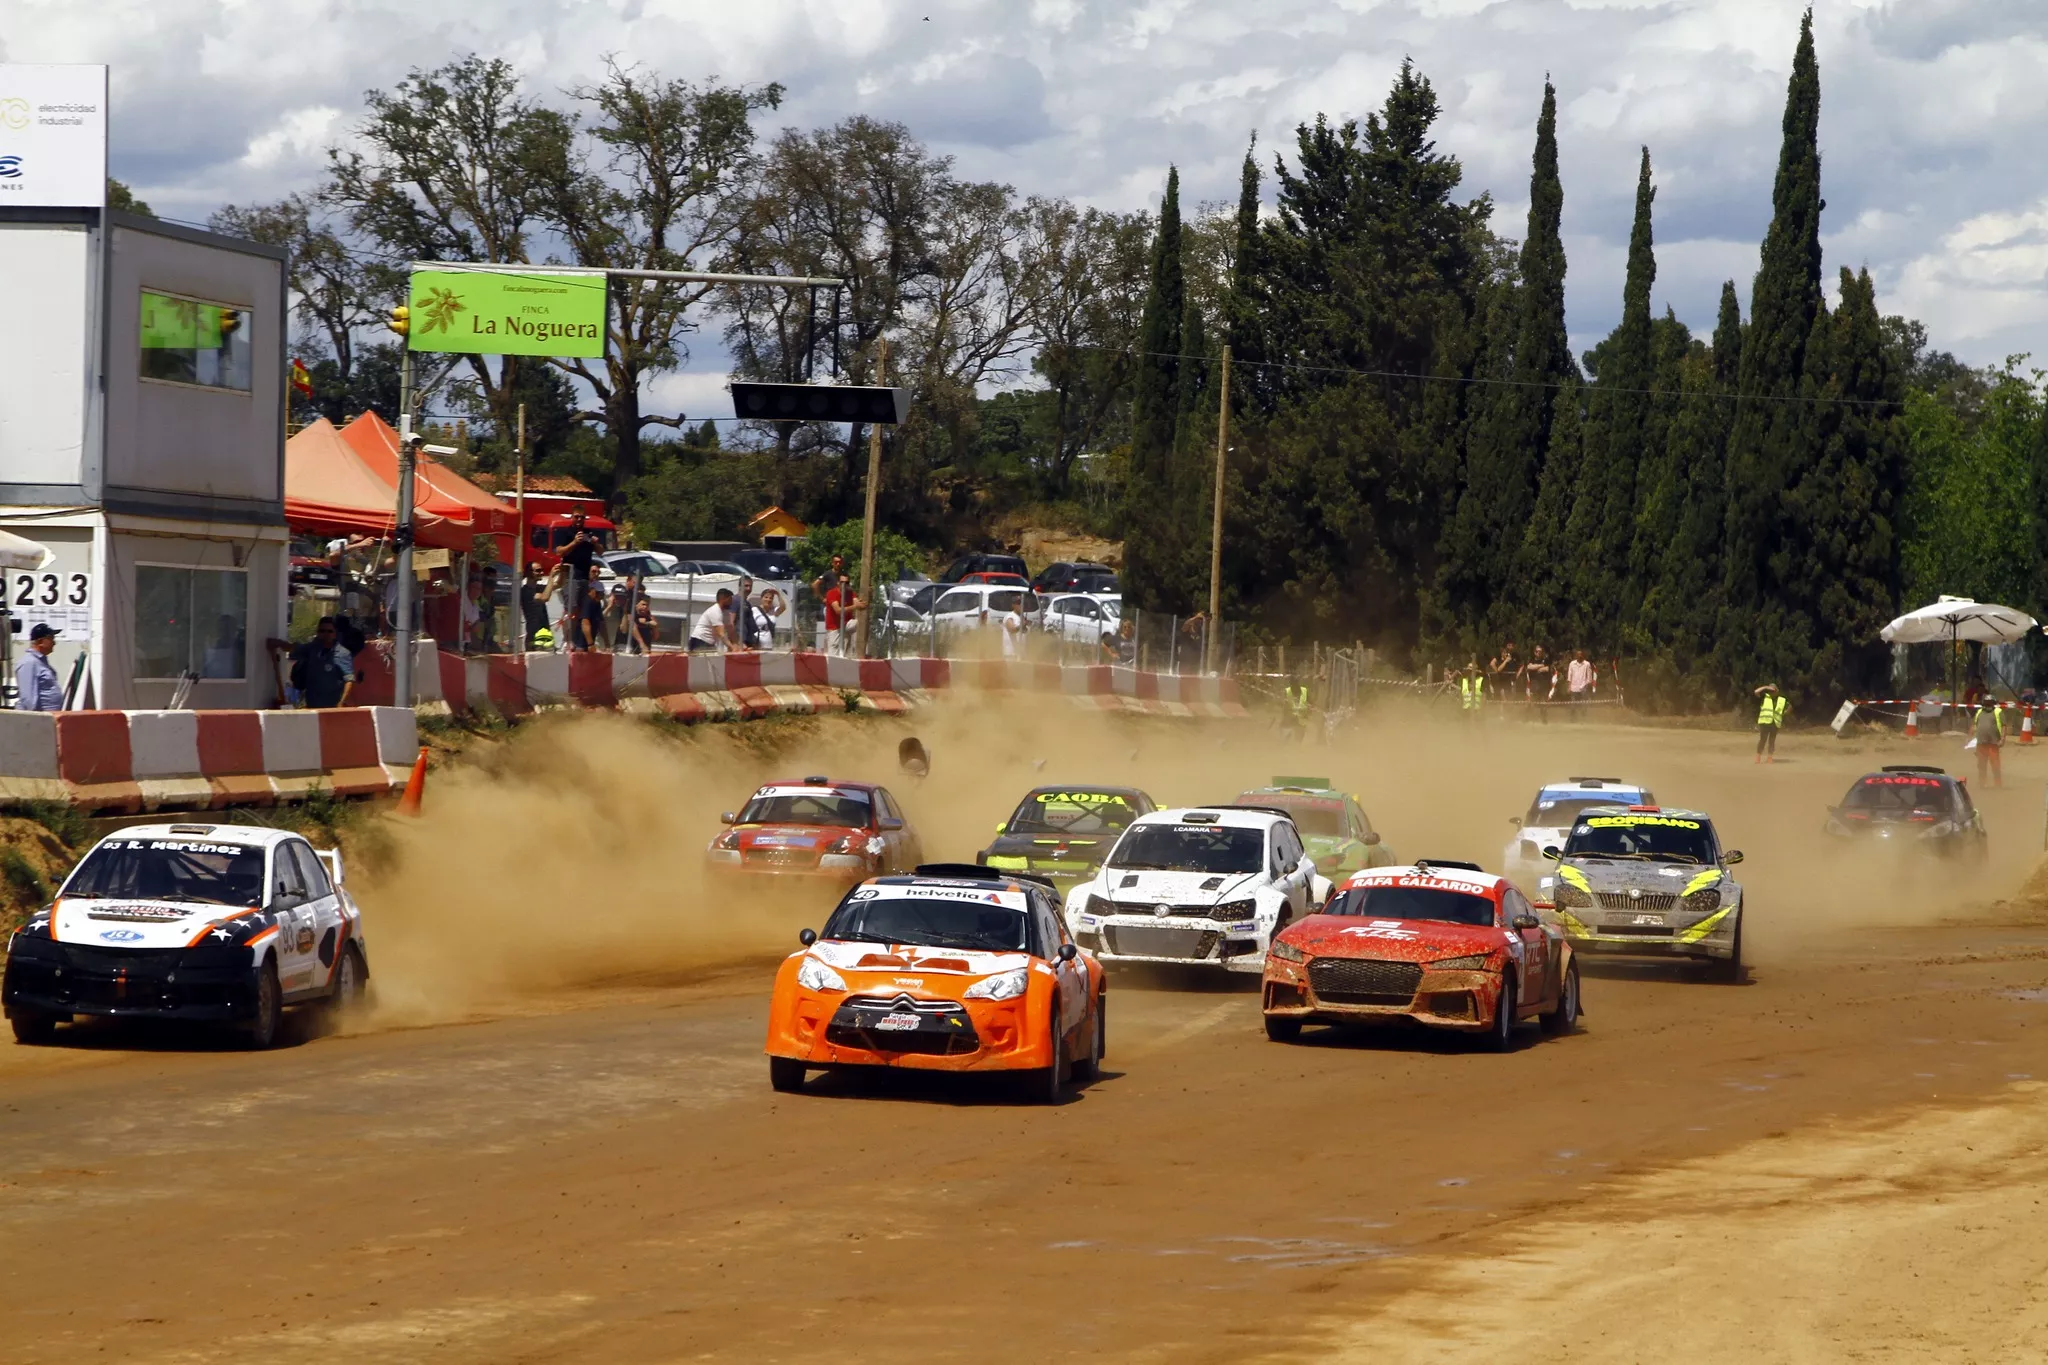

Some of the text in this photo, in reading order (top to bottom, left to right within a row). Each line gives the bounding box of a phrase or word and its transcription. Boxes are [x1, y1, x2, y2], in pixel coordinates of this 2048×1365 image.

[38, 103, 96, 112] electricidad
[38, 116, 83, 125] industrial
[522, 305, 550, 314] FINCA
[473, 315, 598, 341] La Noguera
[1036, 793, 1125, 805] CAOBA
[1576, 826, 1590, 834] 16
[127, 840, 144, 849] R.
[1352, 877, 1484, 895] RAFA GALLARDO
[854, 890, 874, 900] 49
[906, 889, 979, 900] helvetia
[1335, 890, 1347, 900] 2
[107, 930, 136, 939] JCB
